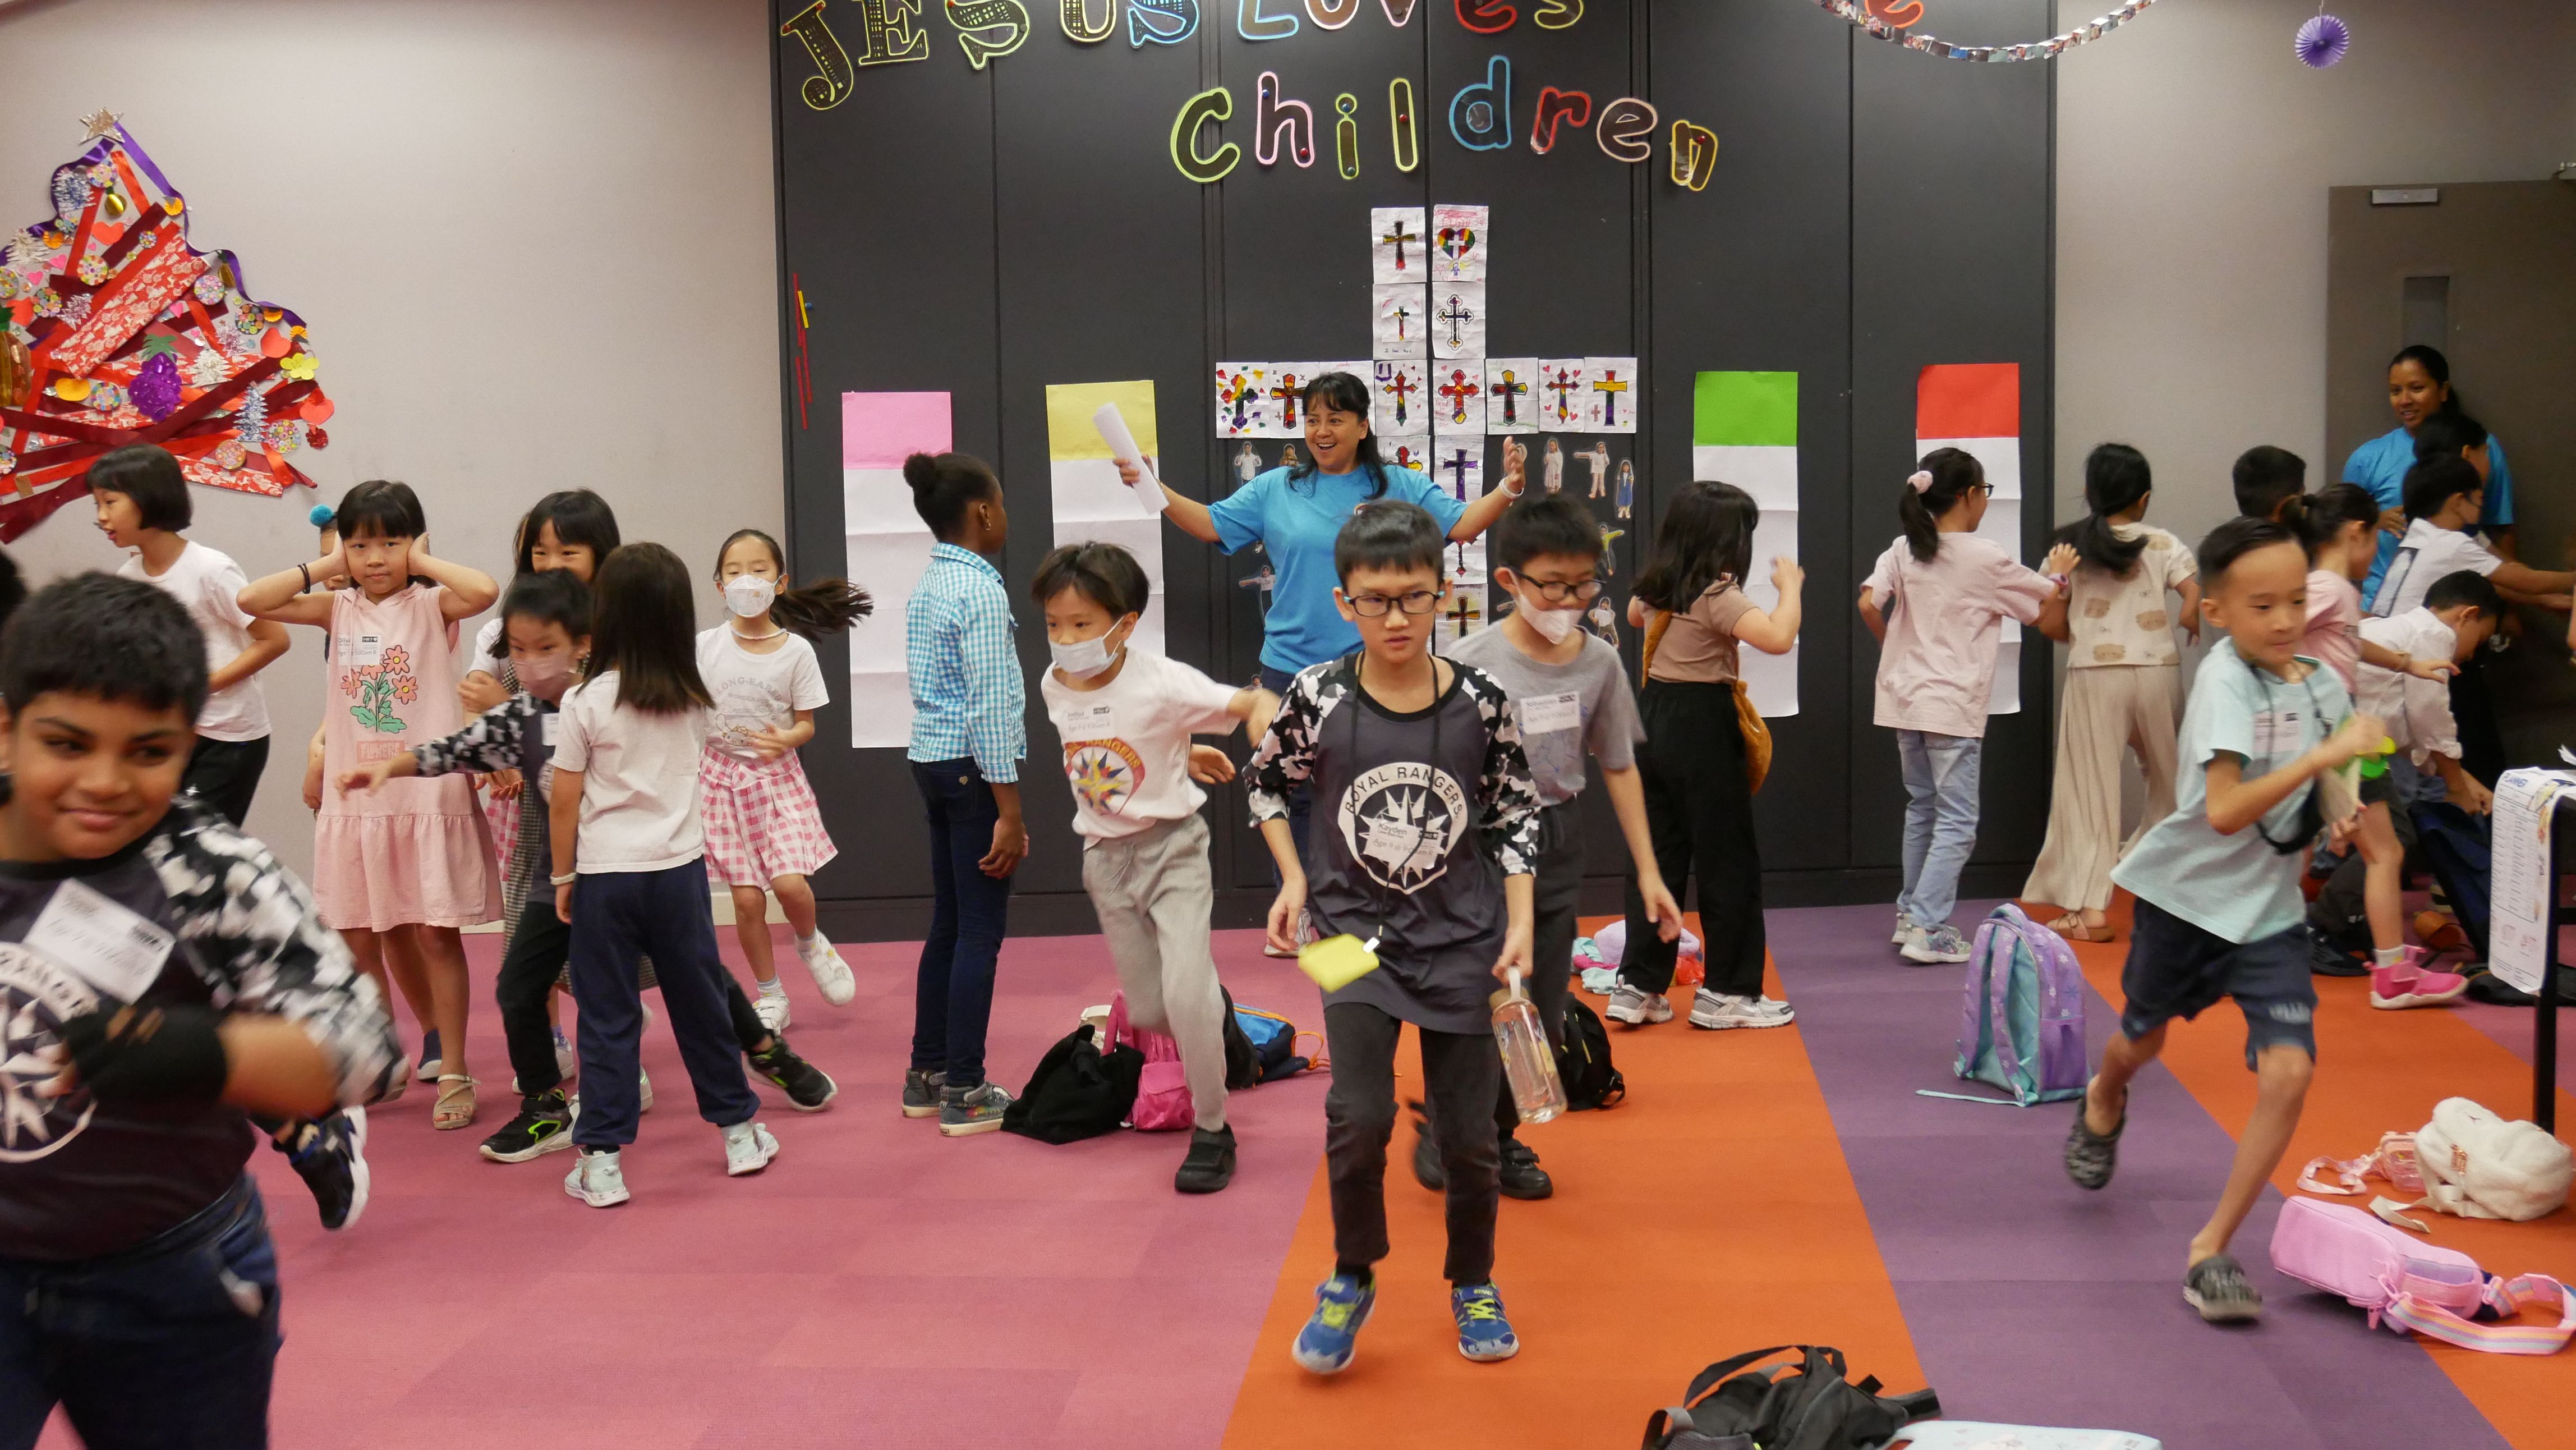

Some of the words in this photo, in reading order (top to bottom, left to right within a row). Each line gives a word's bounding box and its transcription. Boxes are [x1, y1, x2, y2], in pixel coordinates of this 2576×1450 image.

[1170, 54, 1719, 192] Children
[1345, 771, 1389, 815] ROYAL
[1397, 767, 1463, 819] RANGERS
